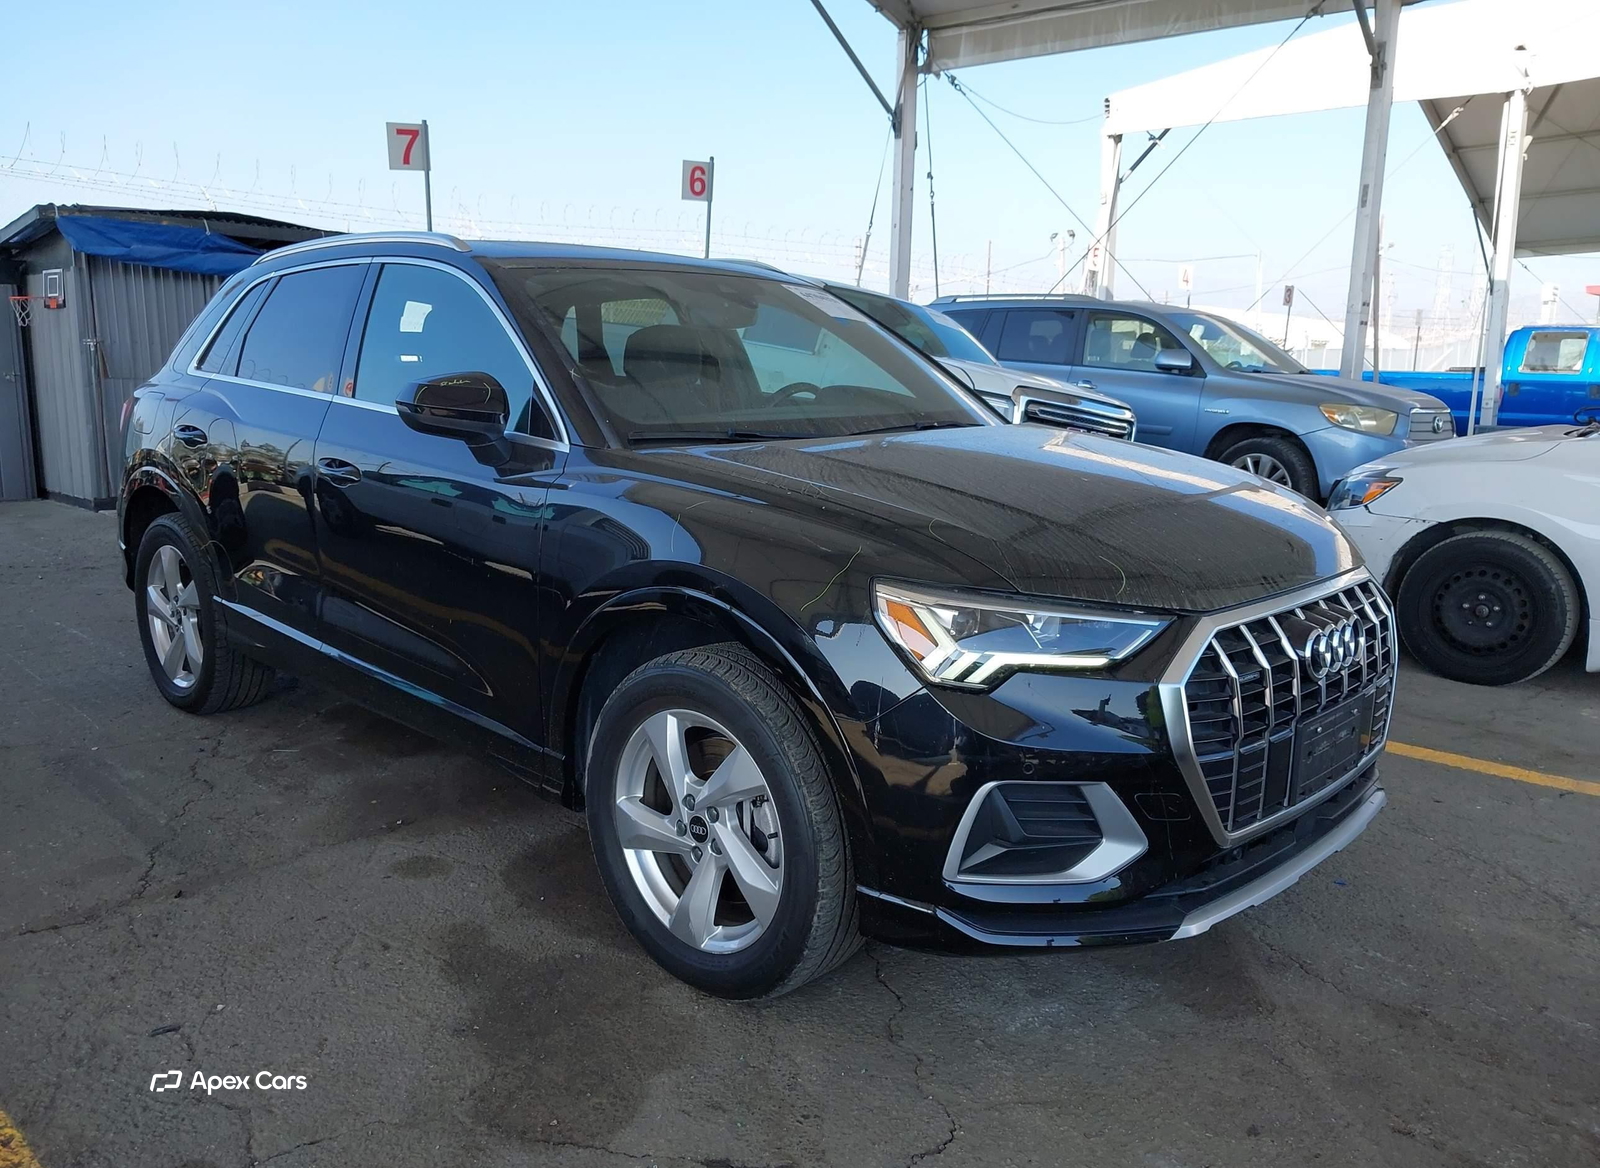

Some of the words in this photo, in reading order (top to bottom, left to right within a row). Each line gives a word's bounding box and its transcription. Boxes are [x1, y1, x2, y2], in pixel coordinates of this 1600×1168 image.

[395, 128, 420, 166] 7
[688, 165, 707, 198] 6
[1182, 269, 1190, 287] 4
[1284, 288, 1292, 304] 3
